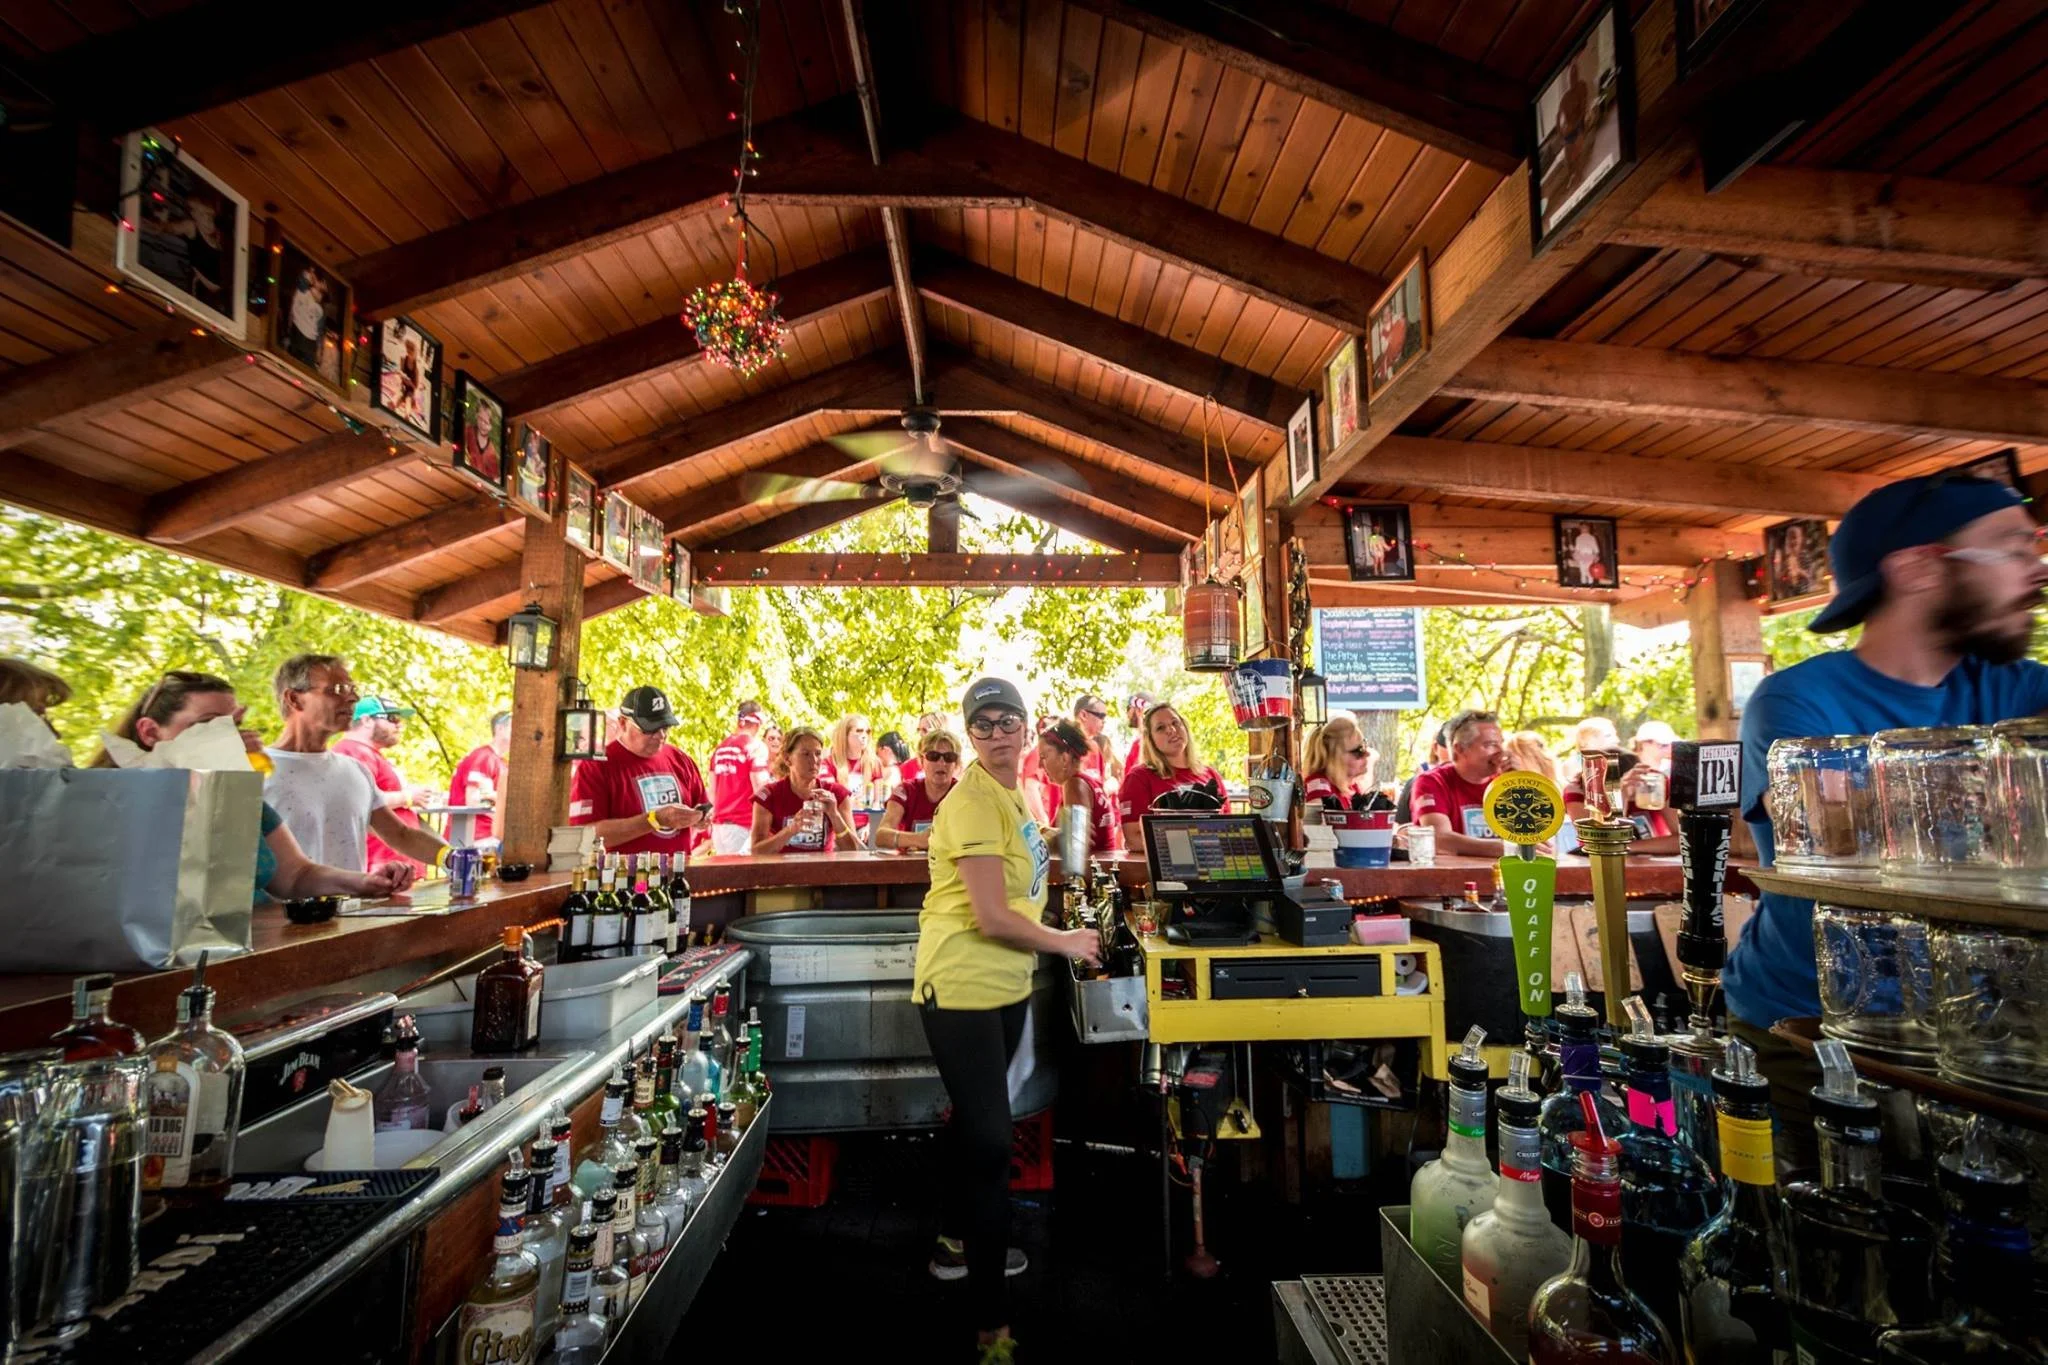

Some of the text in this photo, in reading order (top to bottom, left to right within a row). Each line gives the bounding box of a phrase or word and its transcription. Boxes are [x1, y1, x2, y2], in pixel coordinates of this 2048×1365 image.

[1502, 776, 1541, 788] SIX FOOT
[1700, 759, 1737, 796] IPA
[1710, 828, 1732, 927] LAGUNITAS
[1522, 878, 1545, 1003] QUAFF ON
[279, 1051, 321, 1087] JIM BEAM
